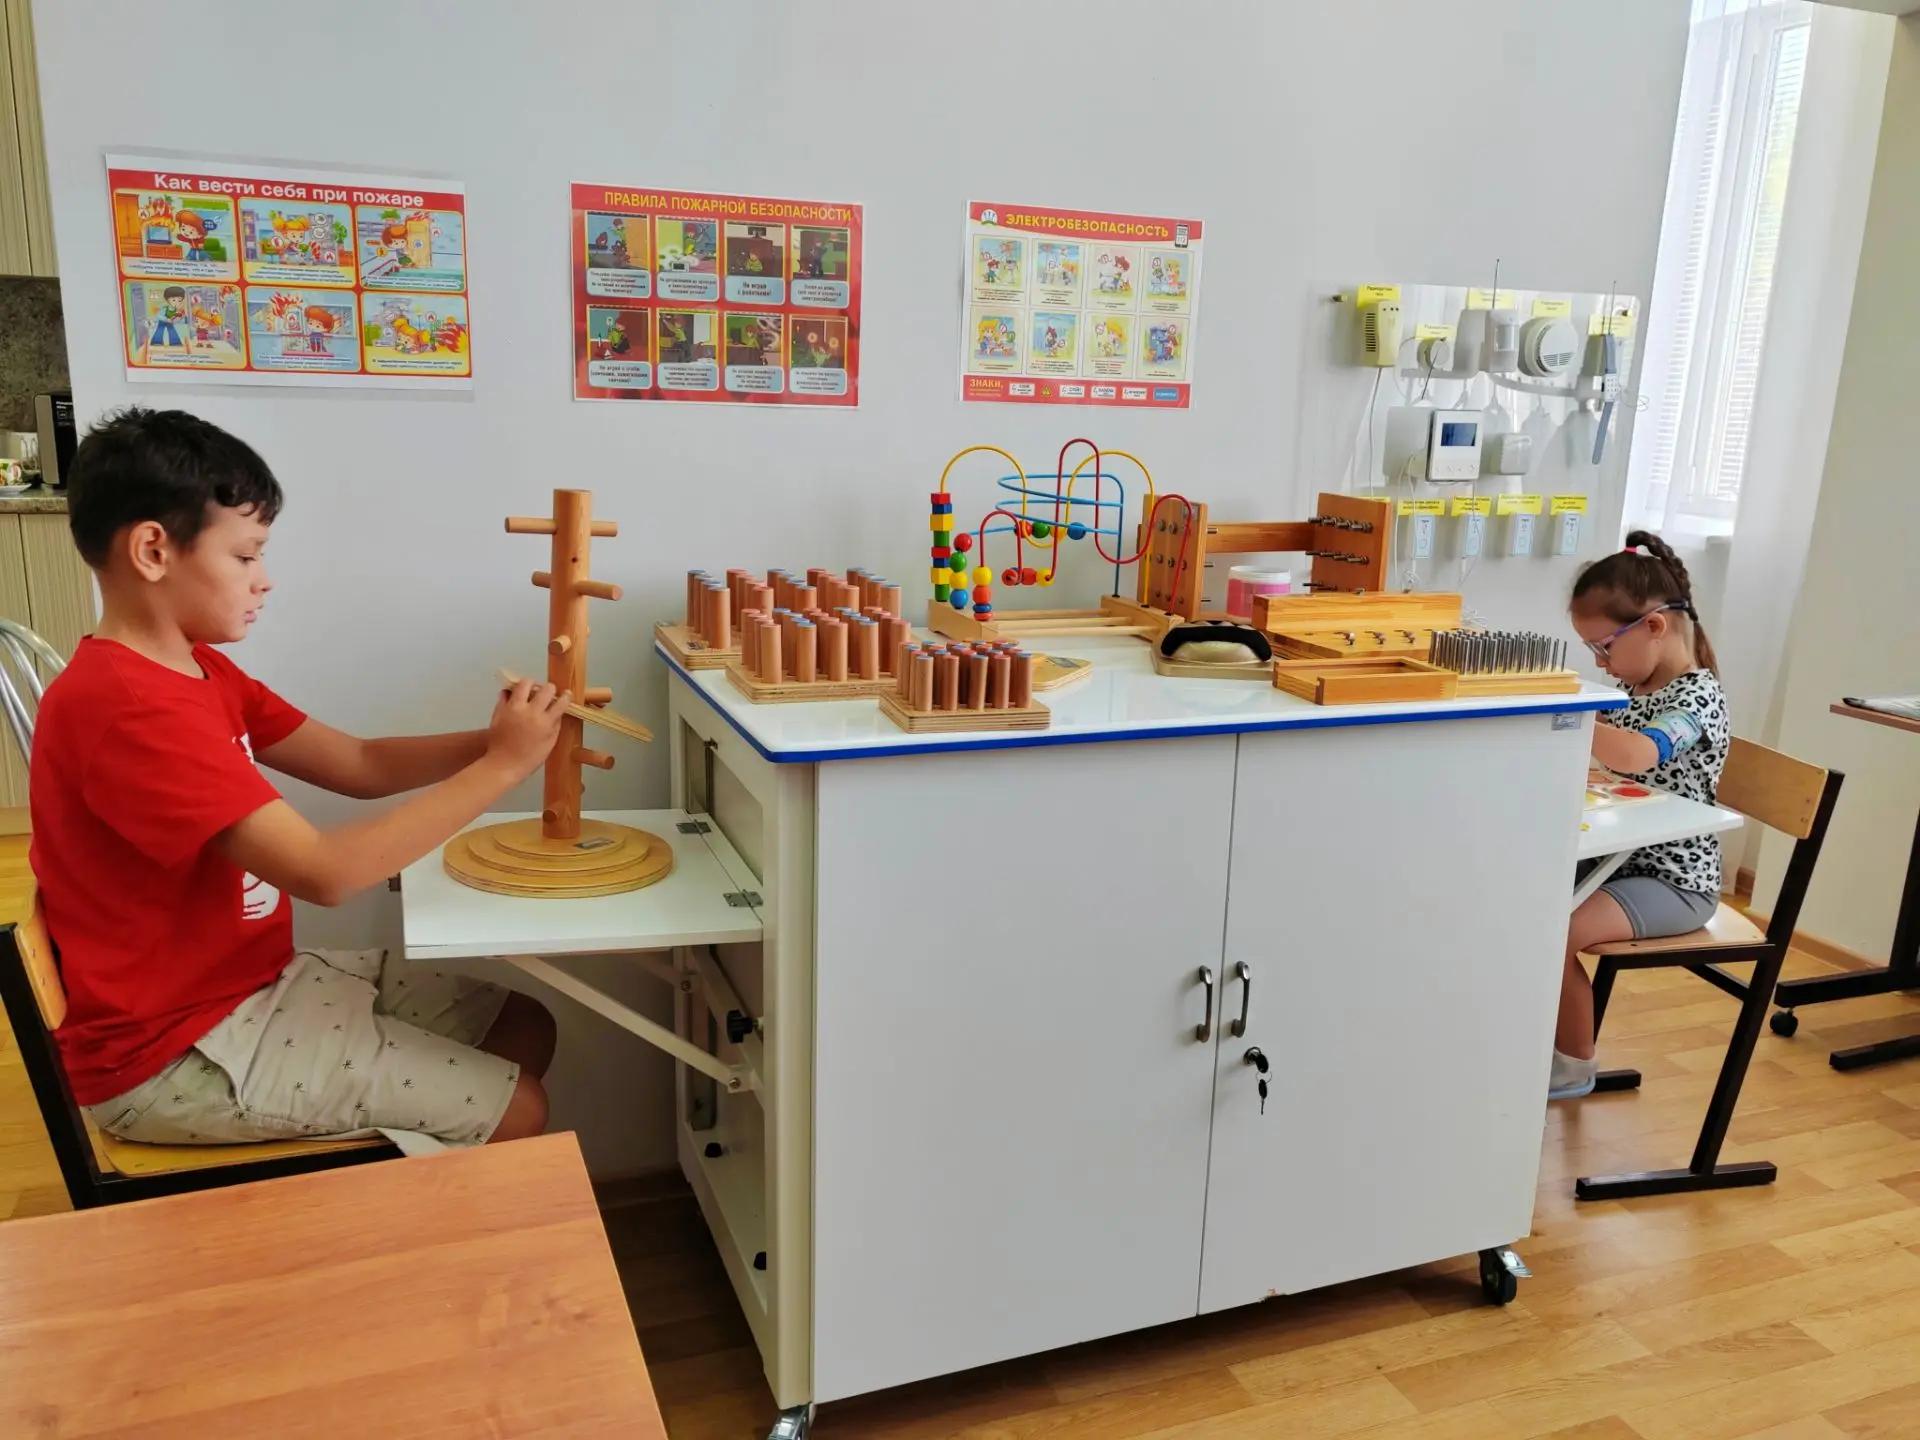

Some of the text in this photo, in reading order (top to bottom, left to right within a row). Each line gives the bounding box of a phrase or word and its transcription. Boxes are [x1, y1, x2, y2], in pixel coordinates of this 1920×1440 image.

[154, 173, 425, 209] Как вести себя при пожаре
[604, 191, 852, 222] ПРАВИЛА ПОЖАРНОЙ БЕЗОПАСНОСТИ
[1005, 213, 1169, 238] ЭЛЕКТРОБЕЗОПАСНОСТЬ
